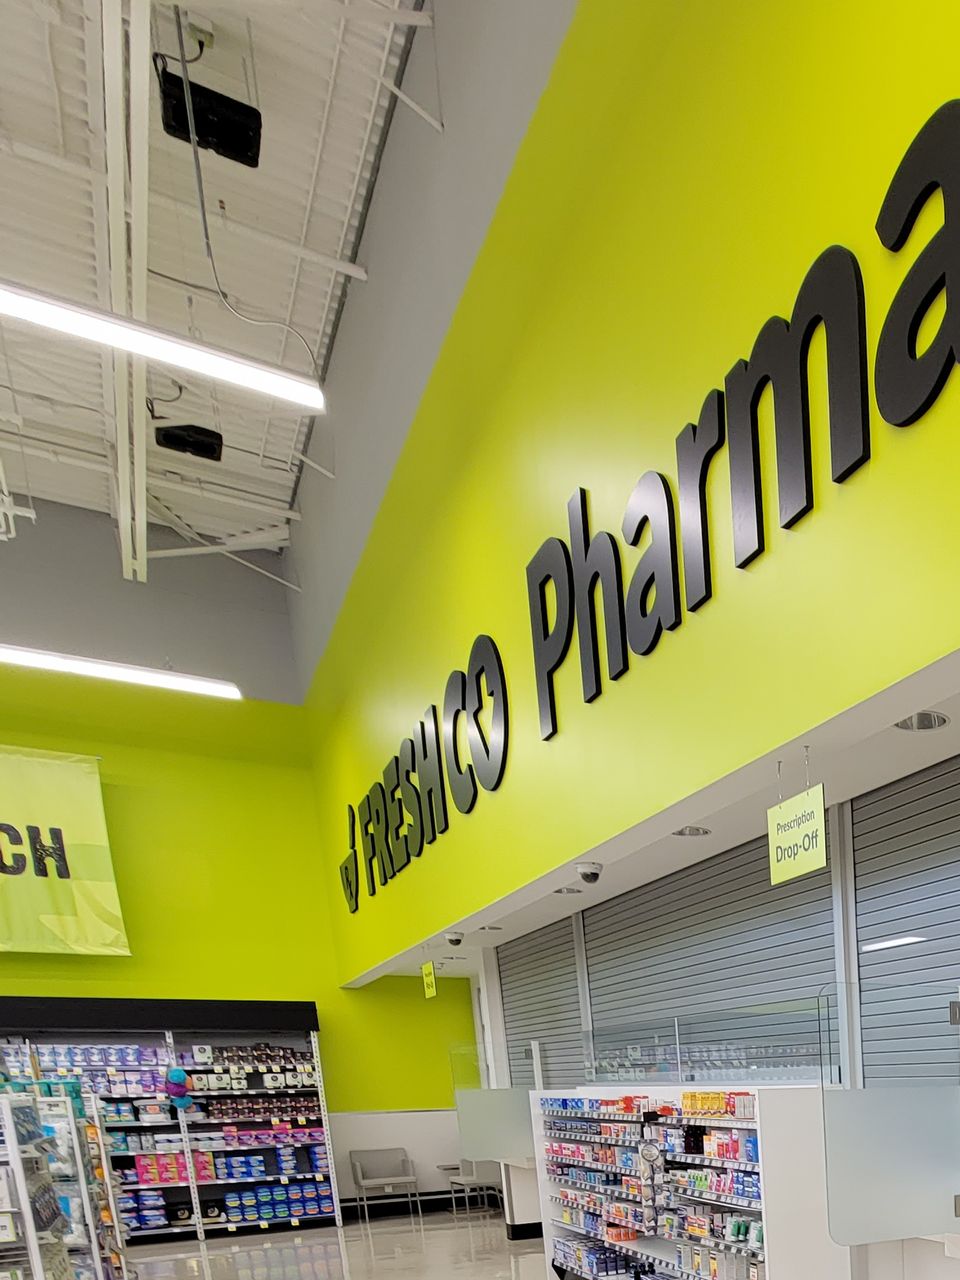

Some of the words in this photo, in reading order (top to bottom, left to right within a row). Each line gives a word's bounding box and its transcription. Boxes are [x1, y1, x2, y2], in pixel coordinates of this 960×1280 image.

[776, 810, 815, 836] Prescription
[0, 822, 71, 879] CH
[775, 828, 819, 863] Drop-Off
